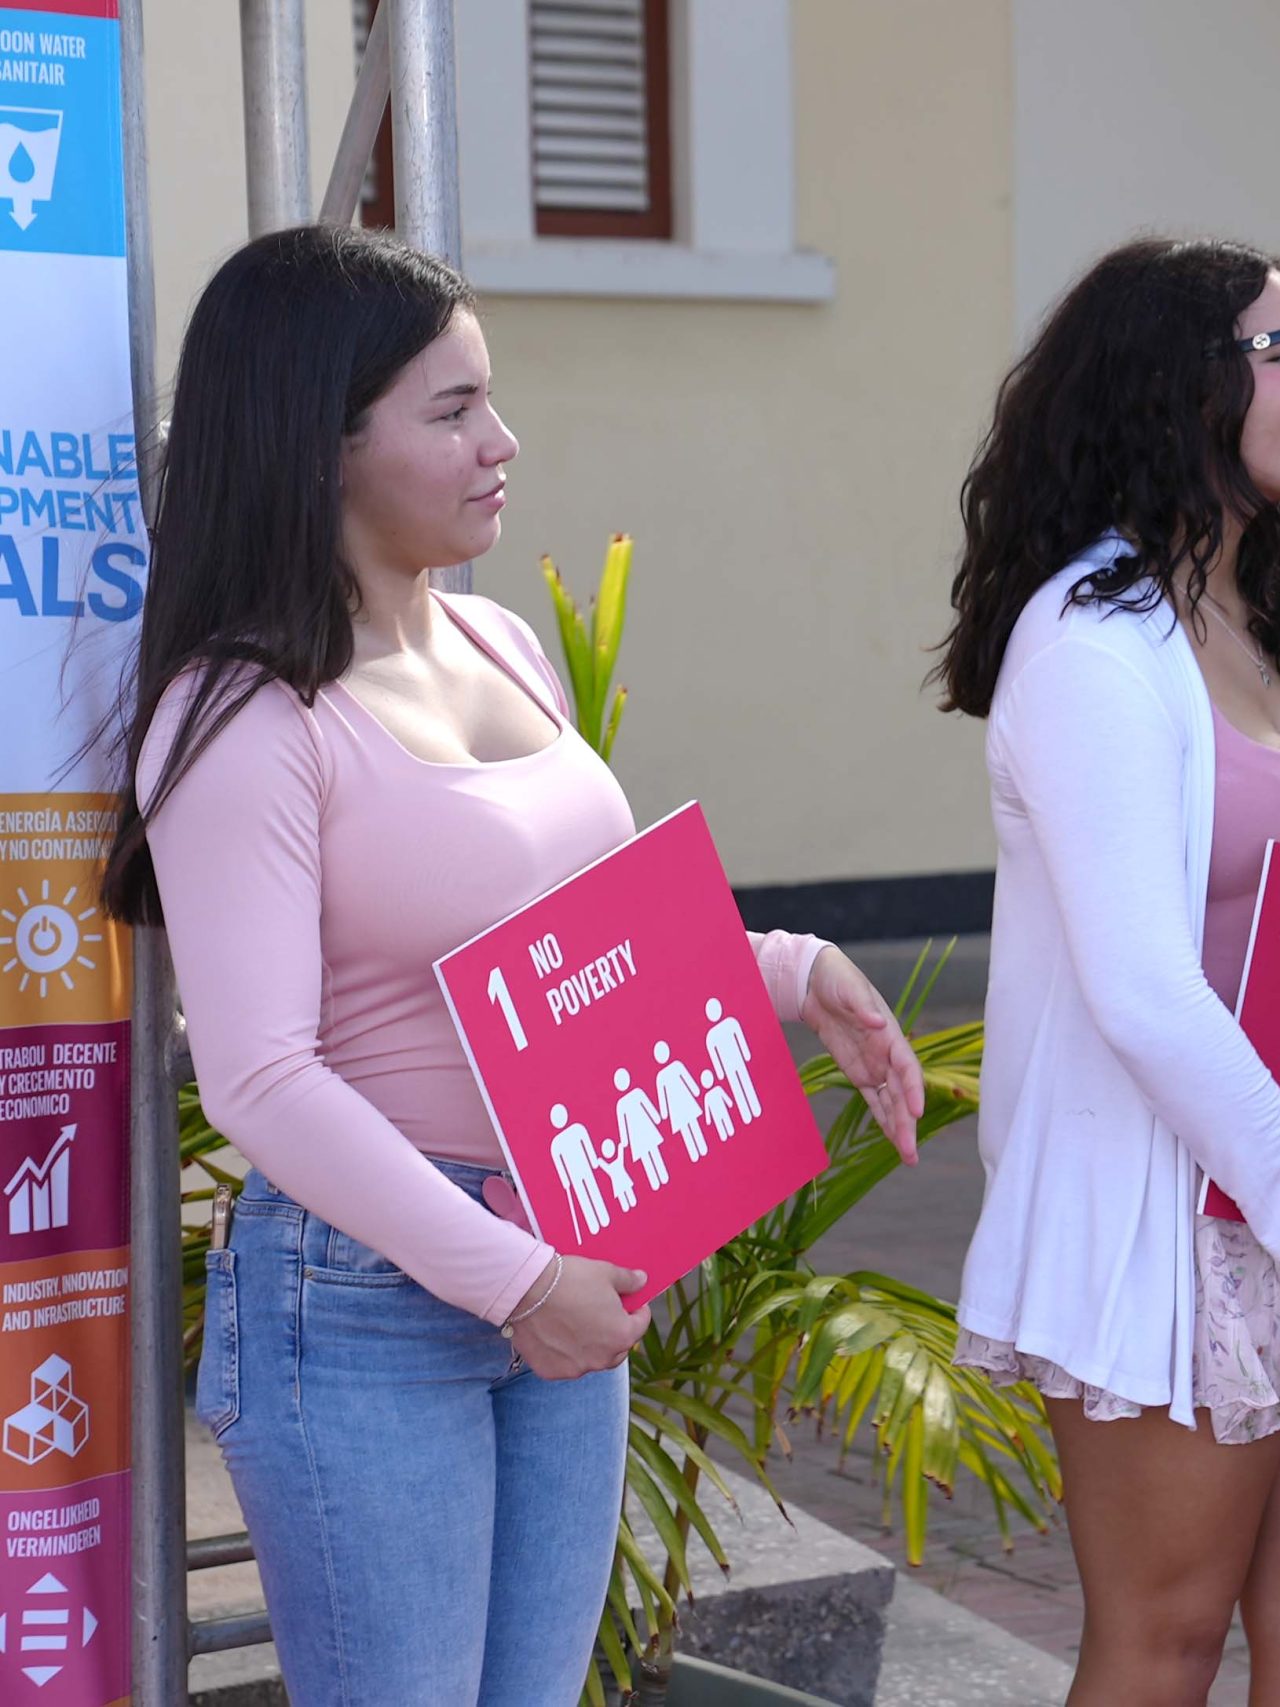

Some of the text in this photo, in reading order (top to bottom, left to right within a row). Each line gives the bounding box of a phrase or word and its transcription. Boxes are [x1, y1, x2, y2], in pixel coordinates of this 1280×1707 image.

[39, 33, 86, 59] WATER
[0, 59, 65, 86] ANITAIR
[10, 838, 29, 860] NO
[528, 932, 564, 980] NO
[545, 938, 638, 1026] POVERTY
[487, 966, 529, 1052] 1
[53, 1041, 117, 1065] DECENTE
[8, 1068, 95, 1095] CRECEMENTO
[0, 1093, 70, 1120] ECONOMICO
[3, 1267, 129, 1305] INDUSTRY, INNOVATION
[2, 1294, 125, 1332] AND INFRASTRUCTURE
[8, 1497, 100, 1532] ONGELIJKHEID
[7, 1524, 101, 1558] VERMINDEREN
